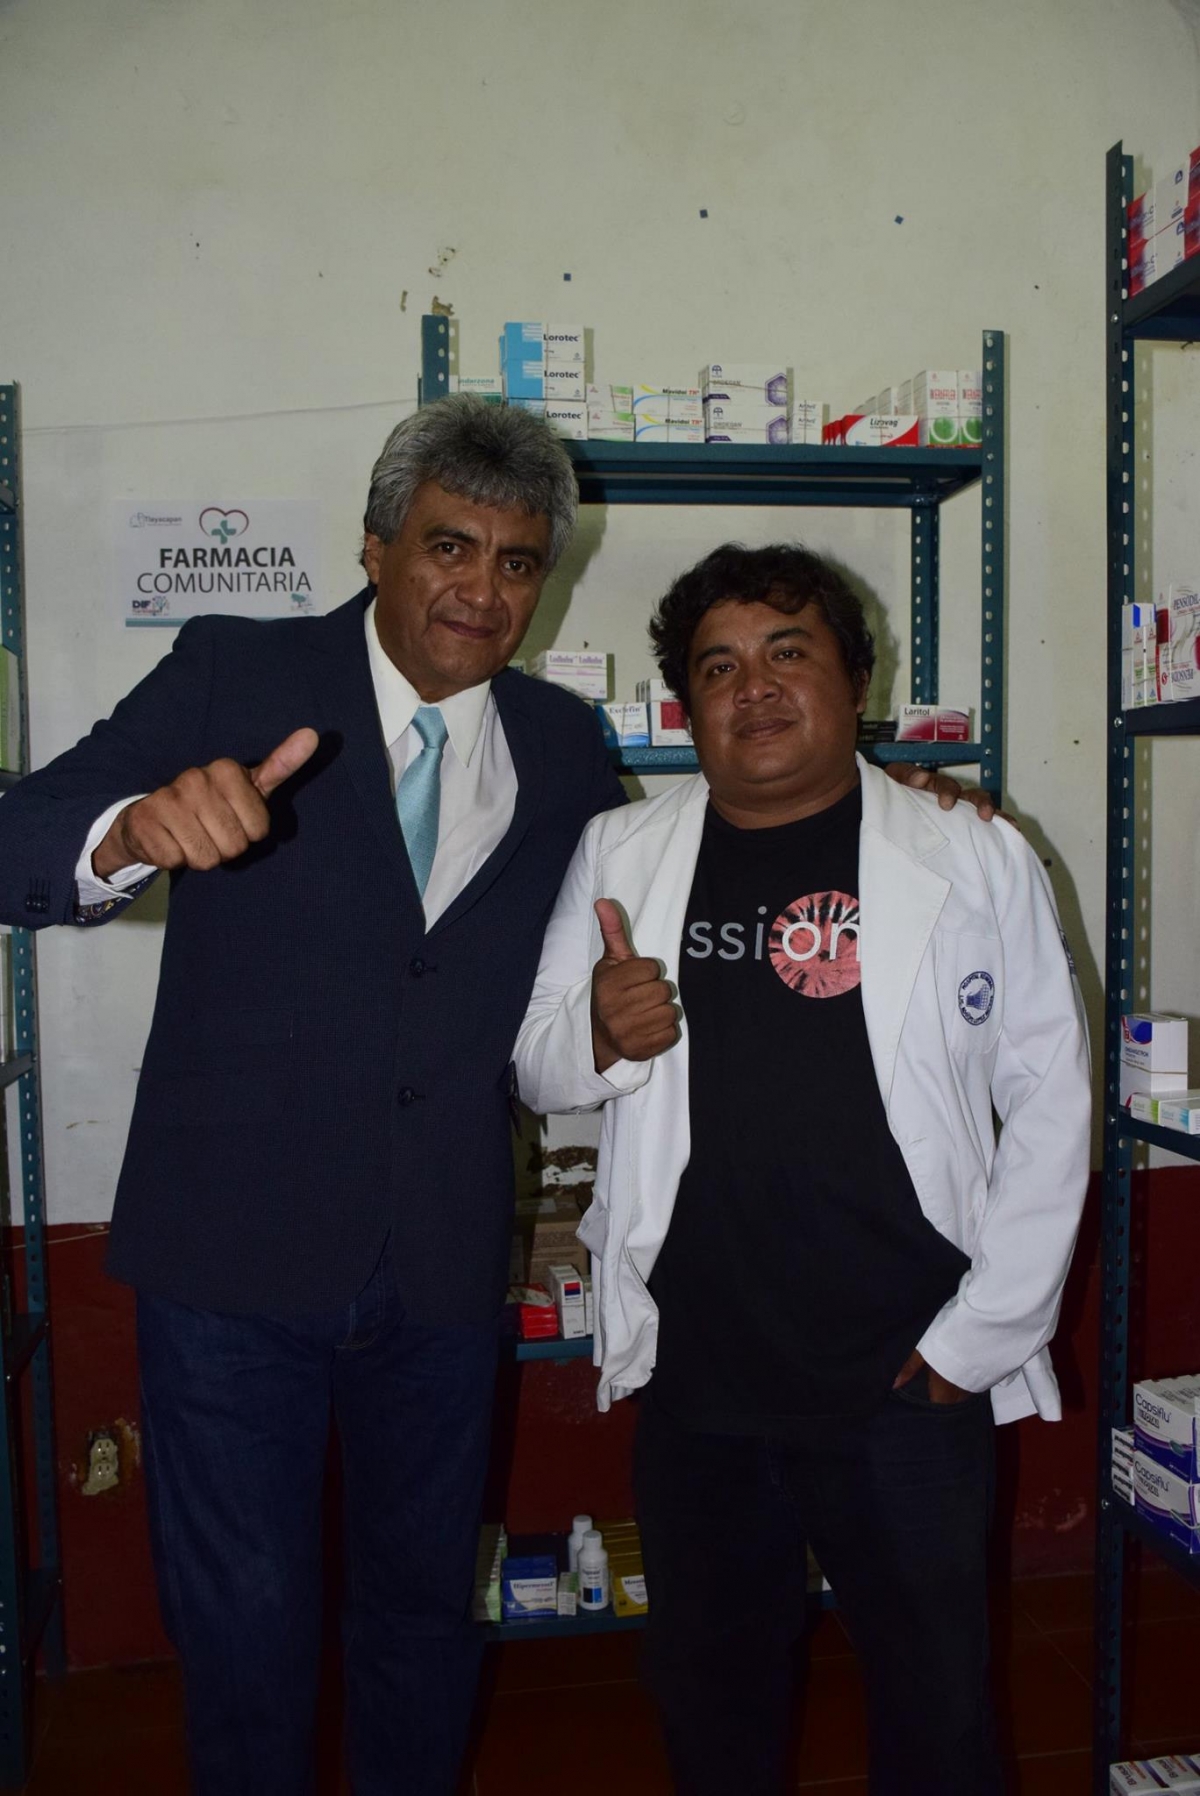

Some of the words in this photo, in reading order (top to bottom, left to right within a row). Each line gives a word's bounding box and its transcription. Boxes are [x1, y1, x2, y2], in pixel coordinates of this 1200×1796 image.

[543, 333, 579, 343] Lorotec
[544, 370, 580, 379] Lorotec
[546, 411, 583, 420] Lorotec
[159, 547, 296, 568] FARMACIA
[137, 571, 312, 594] COMUNITARIA
[132, 600, 151, 609] DIF
[904, 707, 930, 716] Laritol
[1136, 1393, 1172, 1424] Capsiflu
